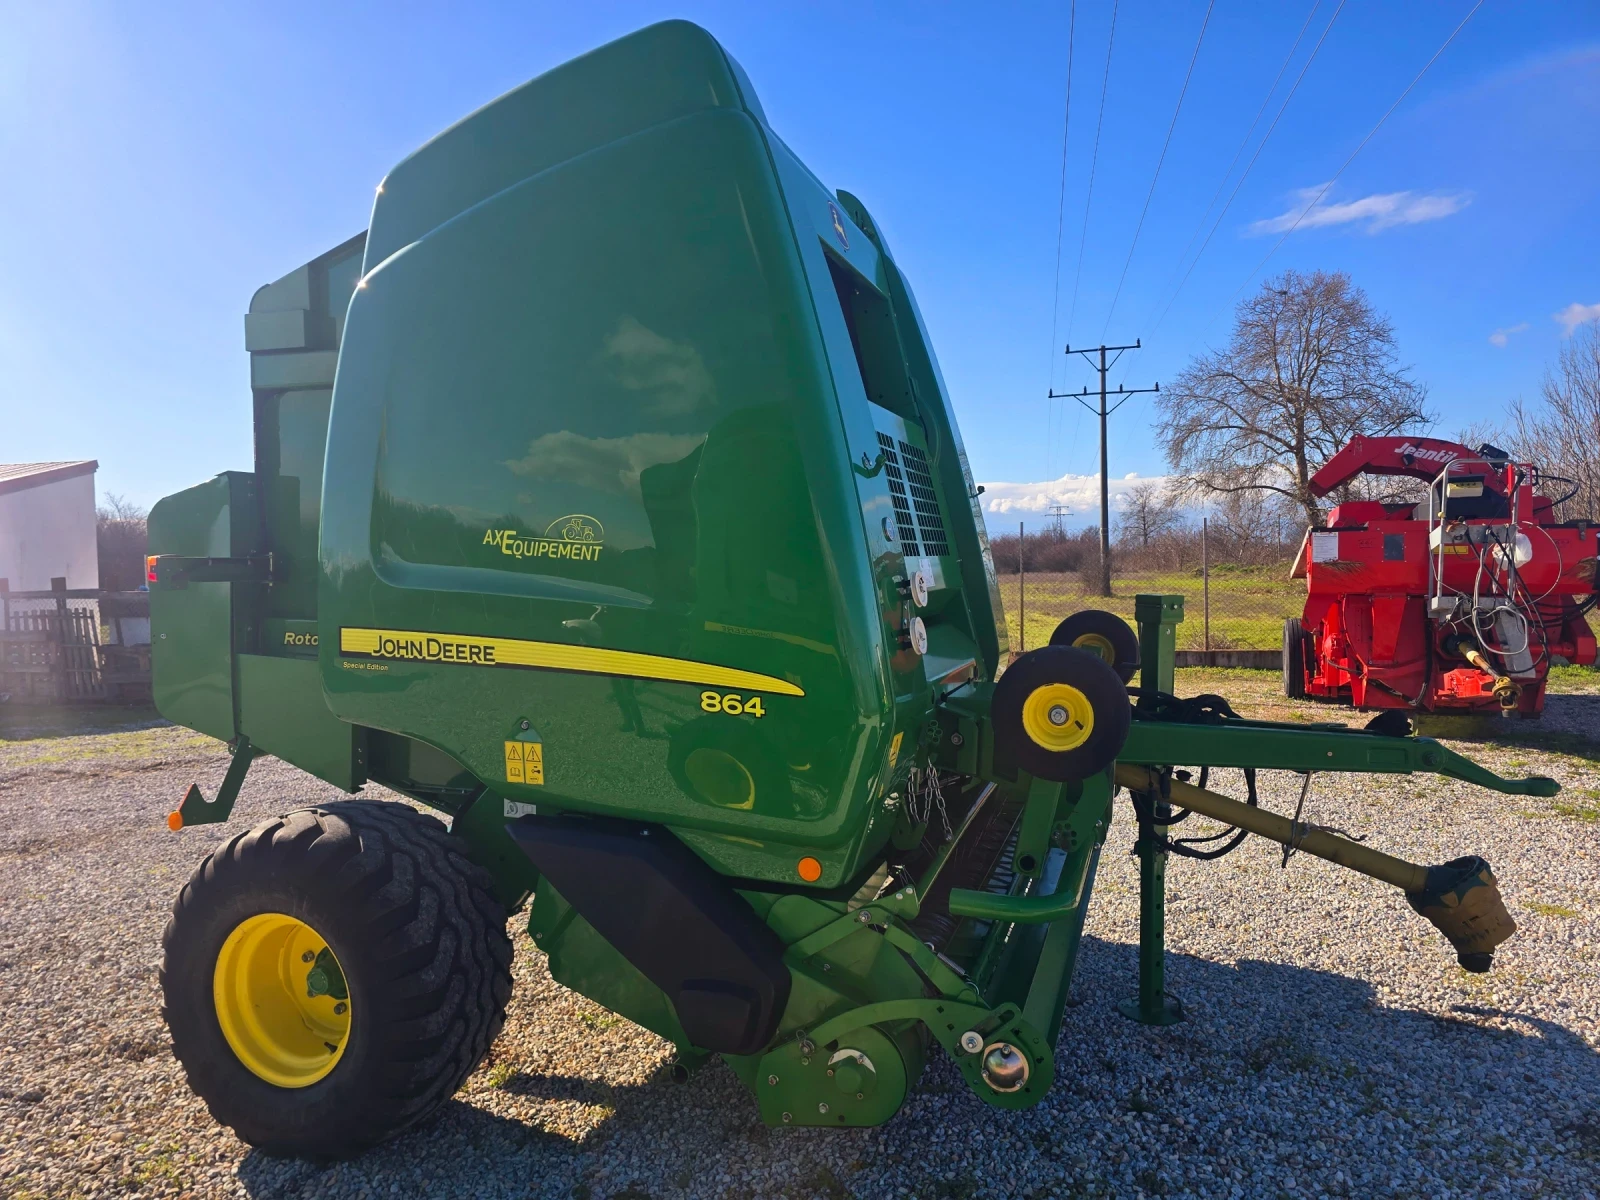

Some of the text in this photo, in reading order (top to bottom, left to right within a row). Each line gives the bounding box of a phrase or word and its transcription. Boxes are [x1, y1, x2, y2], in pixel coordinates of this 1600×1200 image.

[1394, 442, 1459, 463] Jeantil
[372, 635, 496, 663] JOHN DEERE
[343, 661, 389, 671] Special Edition
[700, 690, 766, 718] 864
